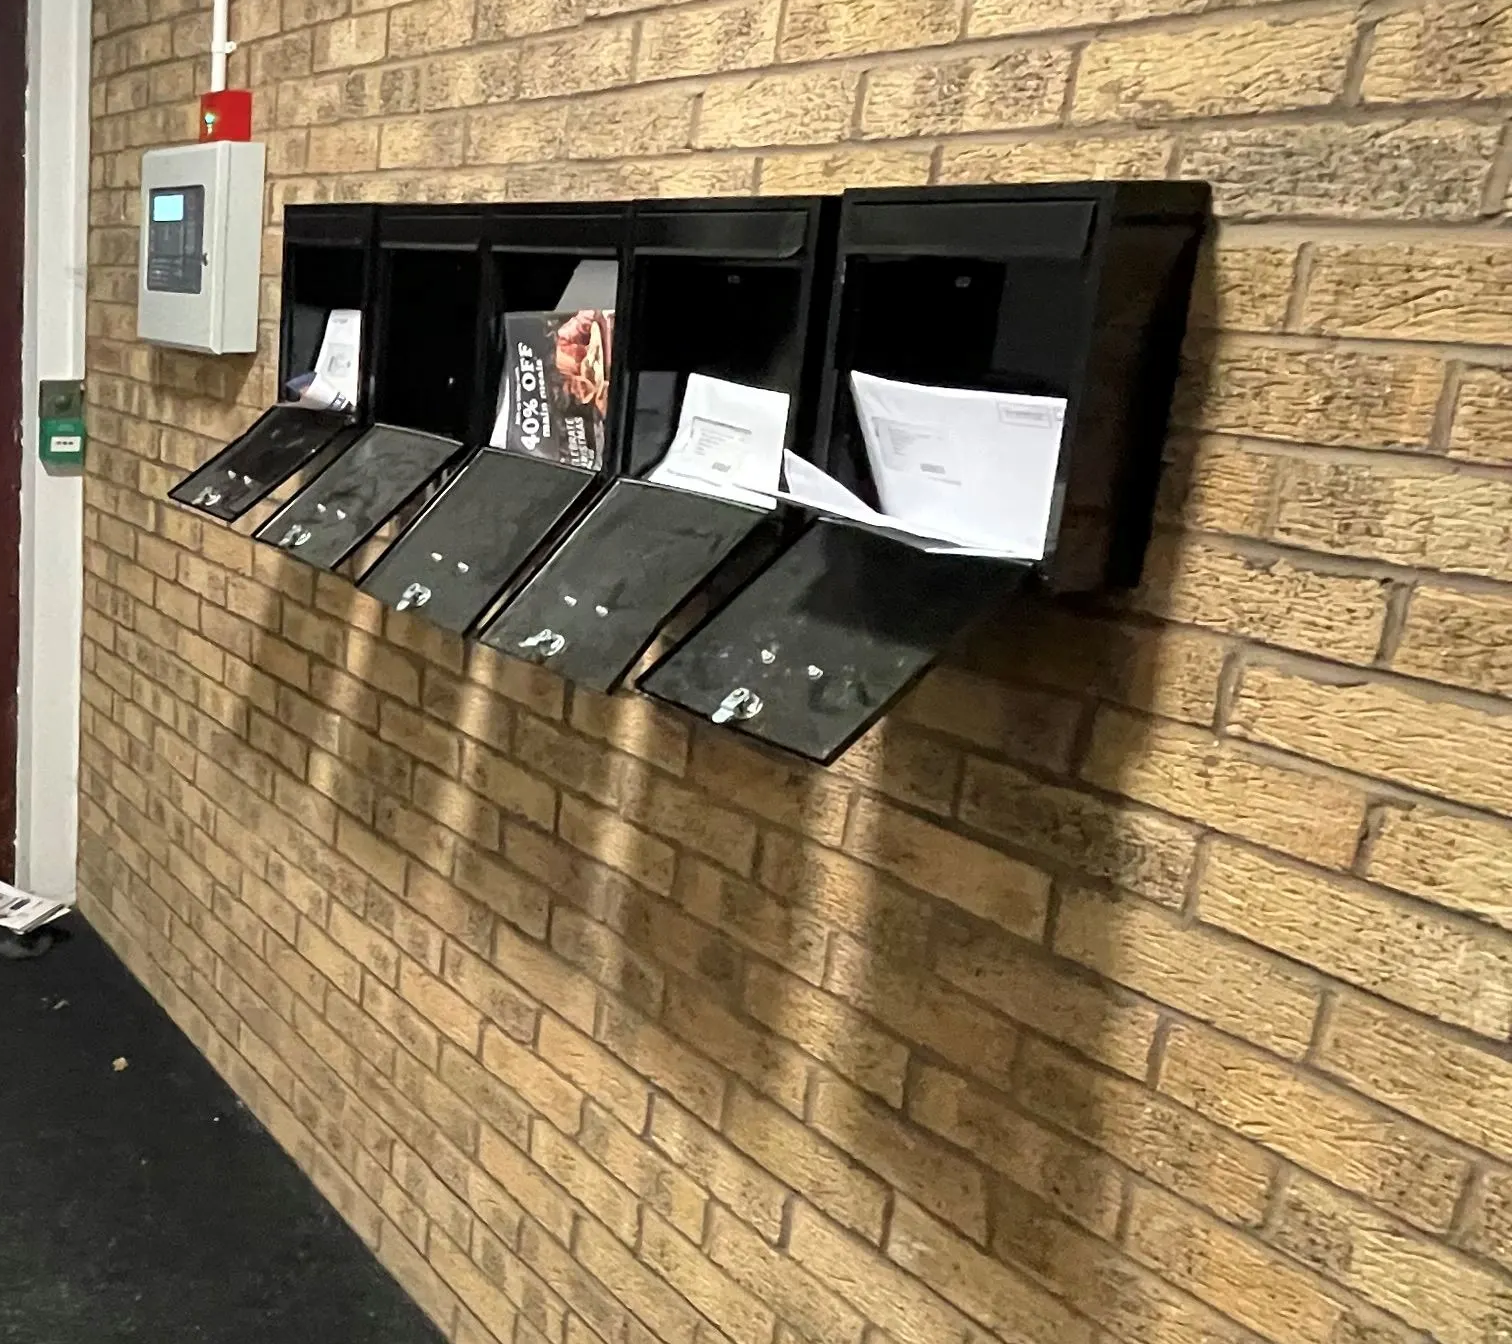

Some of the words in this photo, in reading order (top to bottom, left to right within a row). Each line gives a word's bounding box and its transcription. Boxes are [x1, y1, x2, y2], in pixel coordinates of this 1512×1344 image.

[517, 342, 536, 391] OFF
[520, 398, 540, 451] 40%
[540, 402, 551, 437] main
